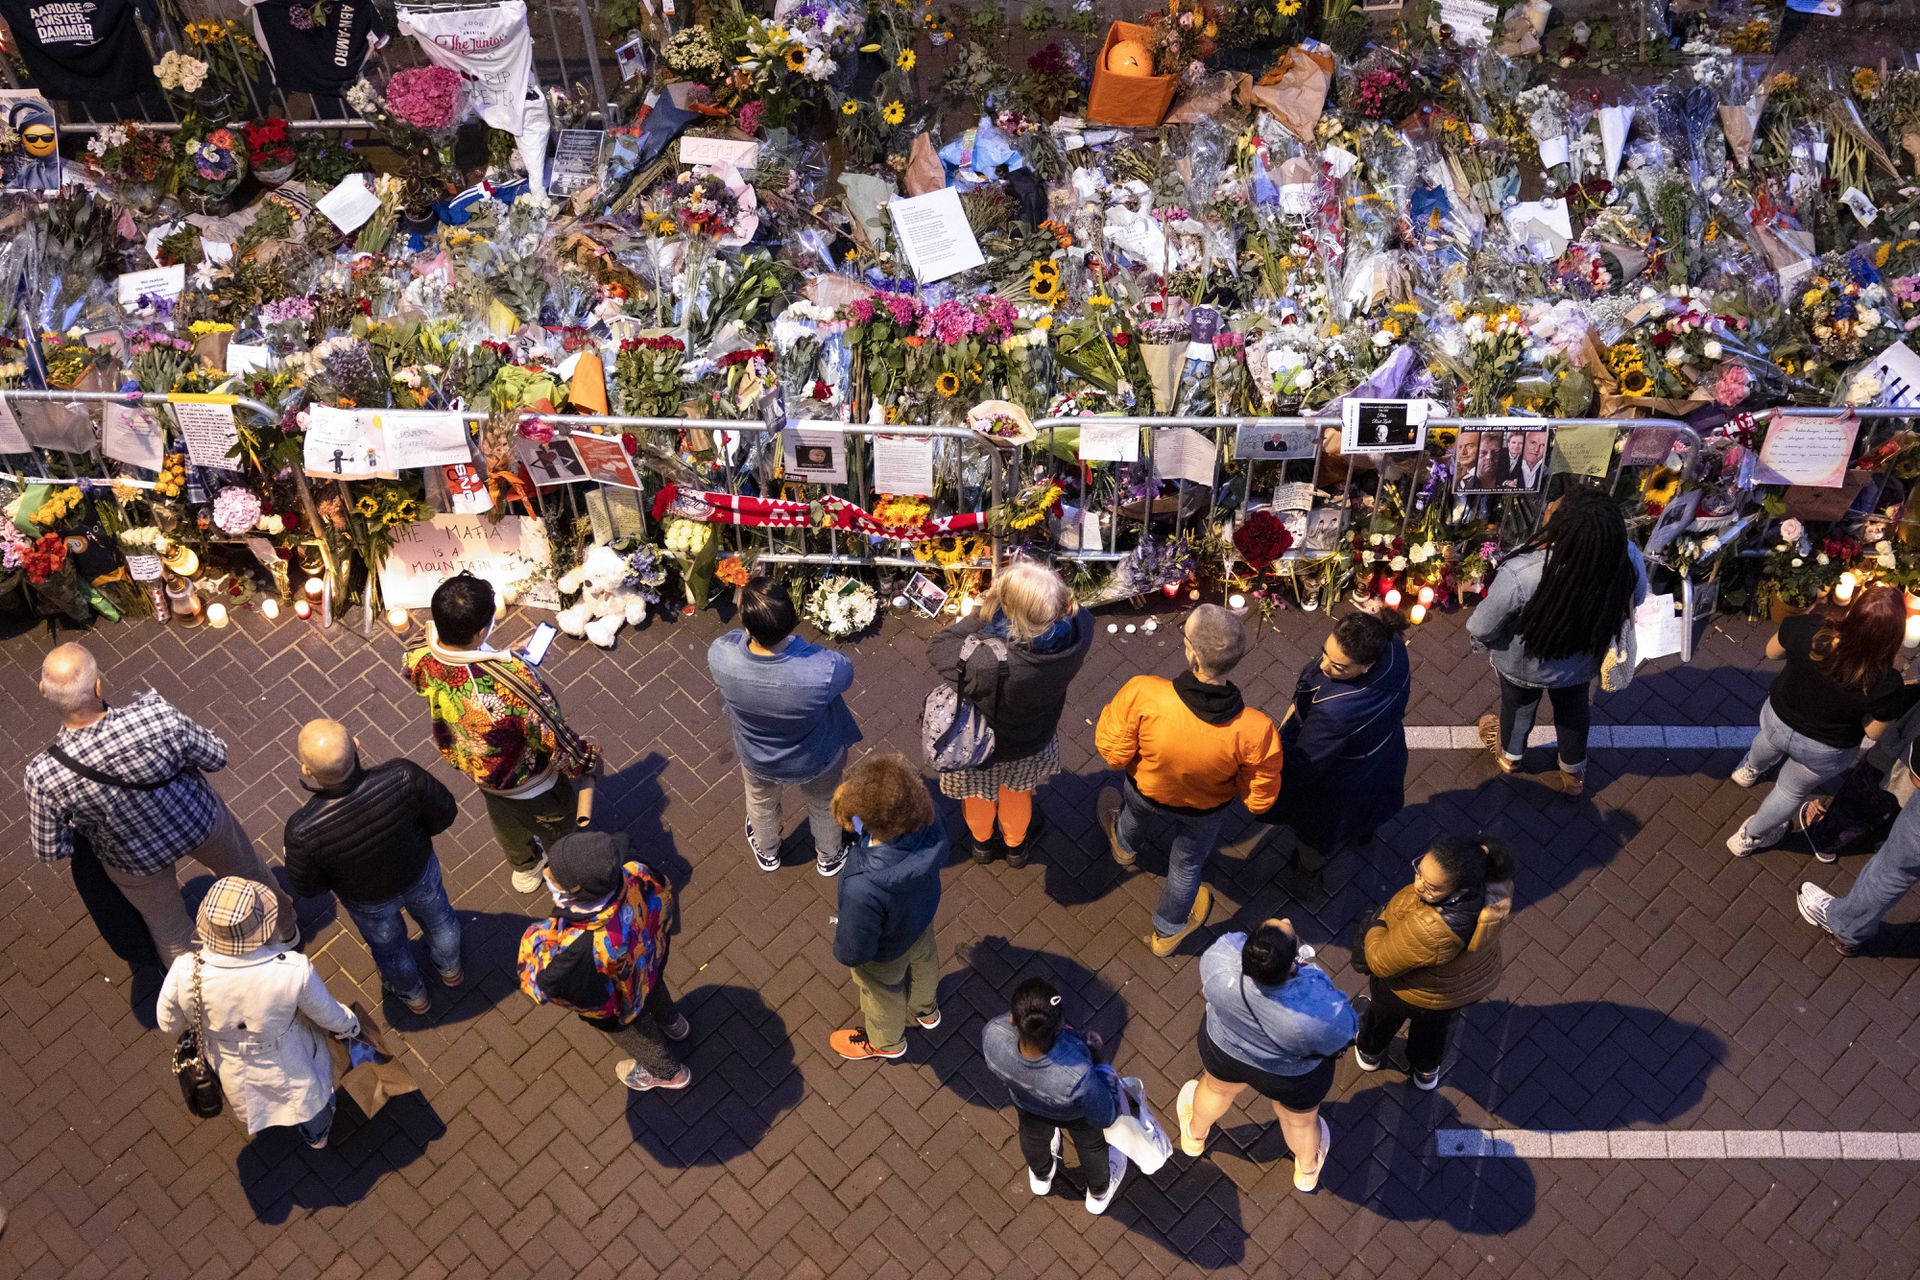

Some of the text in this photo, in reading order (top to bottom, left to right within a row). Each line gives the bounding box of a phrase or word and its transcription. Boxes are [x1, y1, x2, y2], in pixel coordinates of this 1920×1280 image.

[30, 3, 84, 19] AARDIGE
[35, 13, 90, 27] AMSTER-
[37, 24, 93, 39] DAMMER
[435, 34, 469, 51] The
[484, 71, 511, 86] RIP
[468, 88, 515, 107] PETER
[451, 547, 460, 557] A
